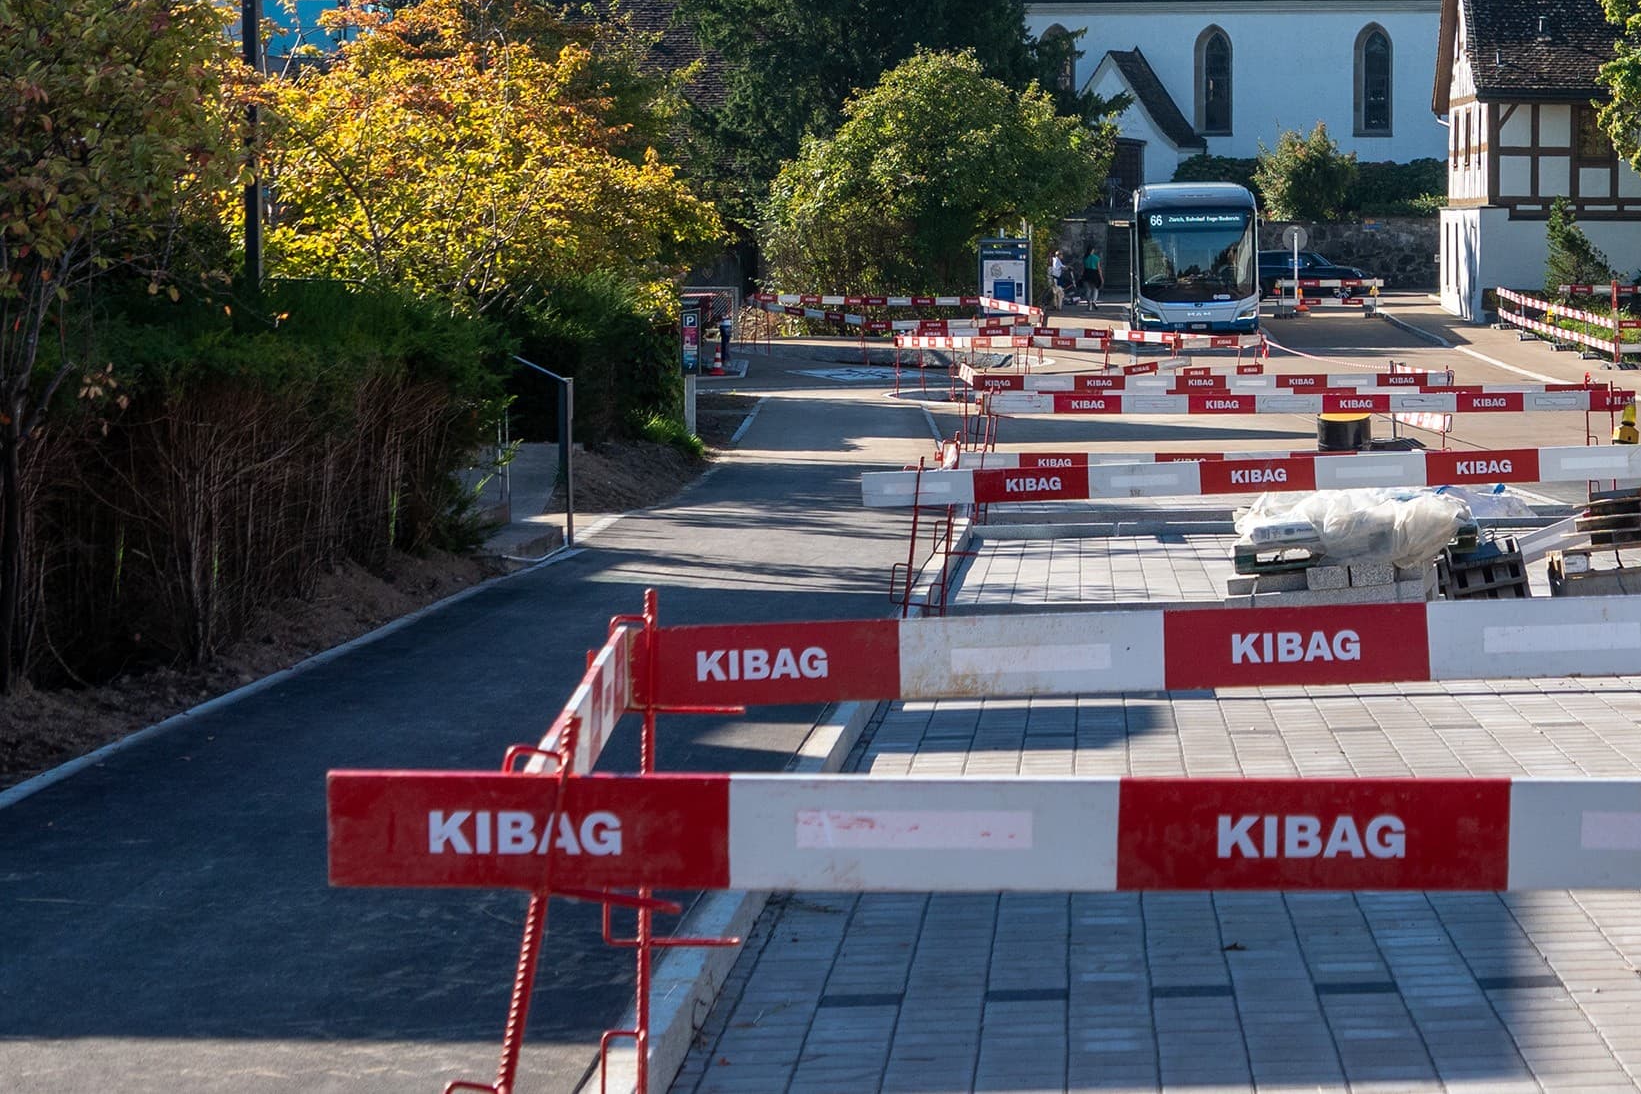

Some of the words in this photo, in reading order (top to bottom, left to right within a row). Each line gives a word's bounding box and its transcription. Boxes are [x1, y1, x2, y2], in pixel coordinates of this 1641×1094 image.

[1150, 215, 1162, 226] 66
[1071, 400, 1105, 409] KIBAG
[1206, 400, 1239, 409] KIBAG
[1340, 399, 1373, 408] KIBAG
[1473, 398, 1506, 407] KIBAG
[1038, 458, 1072, 468] KIBAG
[1456, 459, 1512, 475] KIBAG
[1231, 468, 1287, 484] KIBAG
[1006, 477, 1061, 492] KIBAG
[1232, 630, 1360, 664] KIBAG
[697, 647, 828, 682] KIBAG
[428, 810, 622, 855] KIBAG
[1217, 815, 1406, 859] KIBAG
